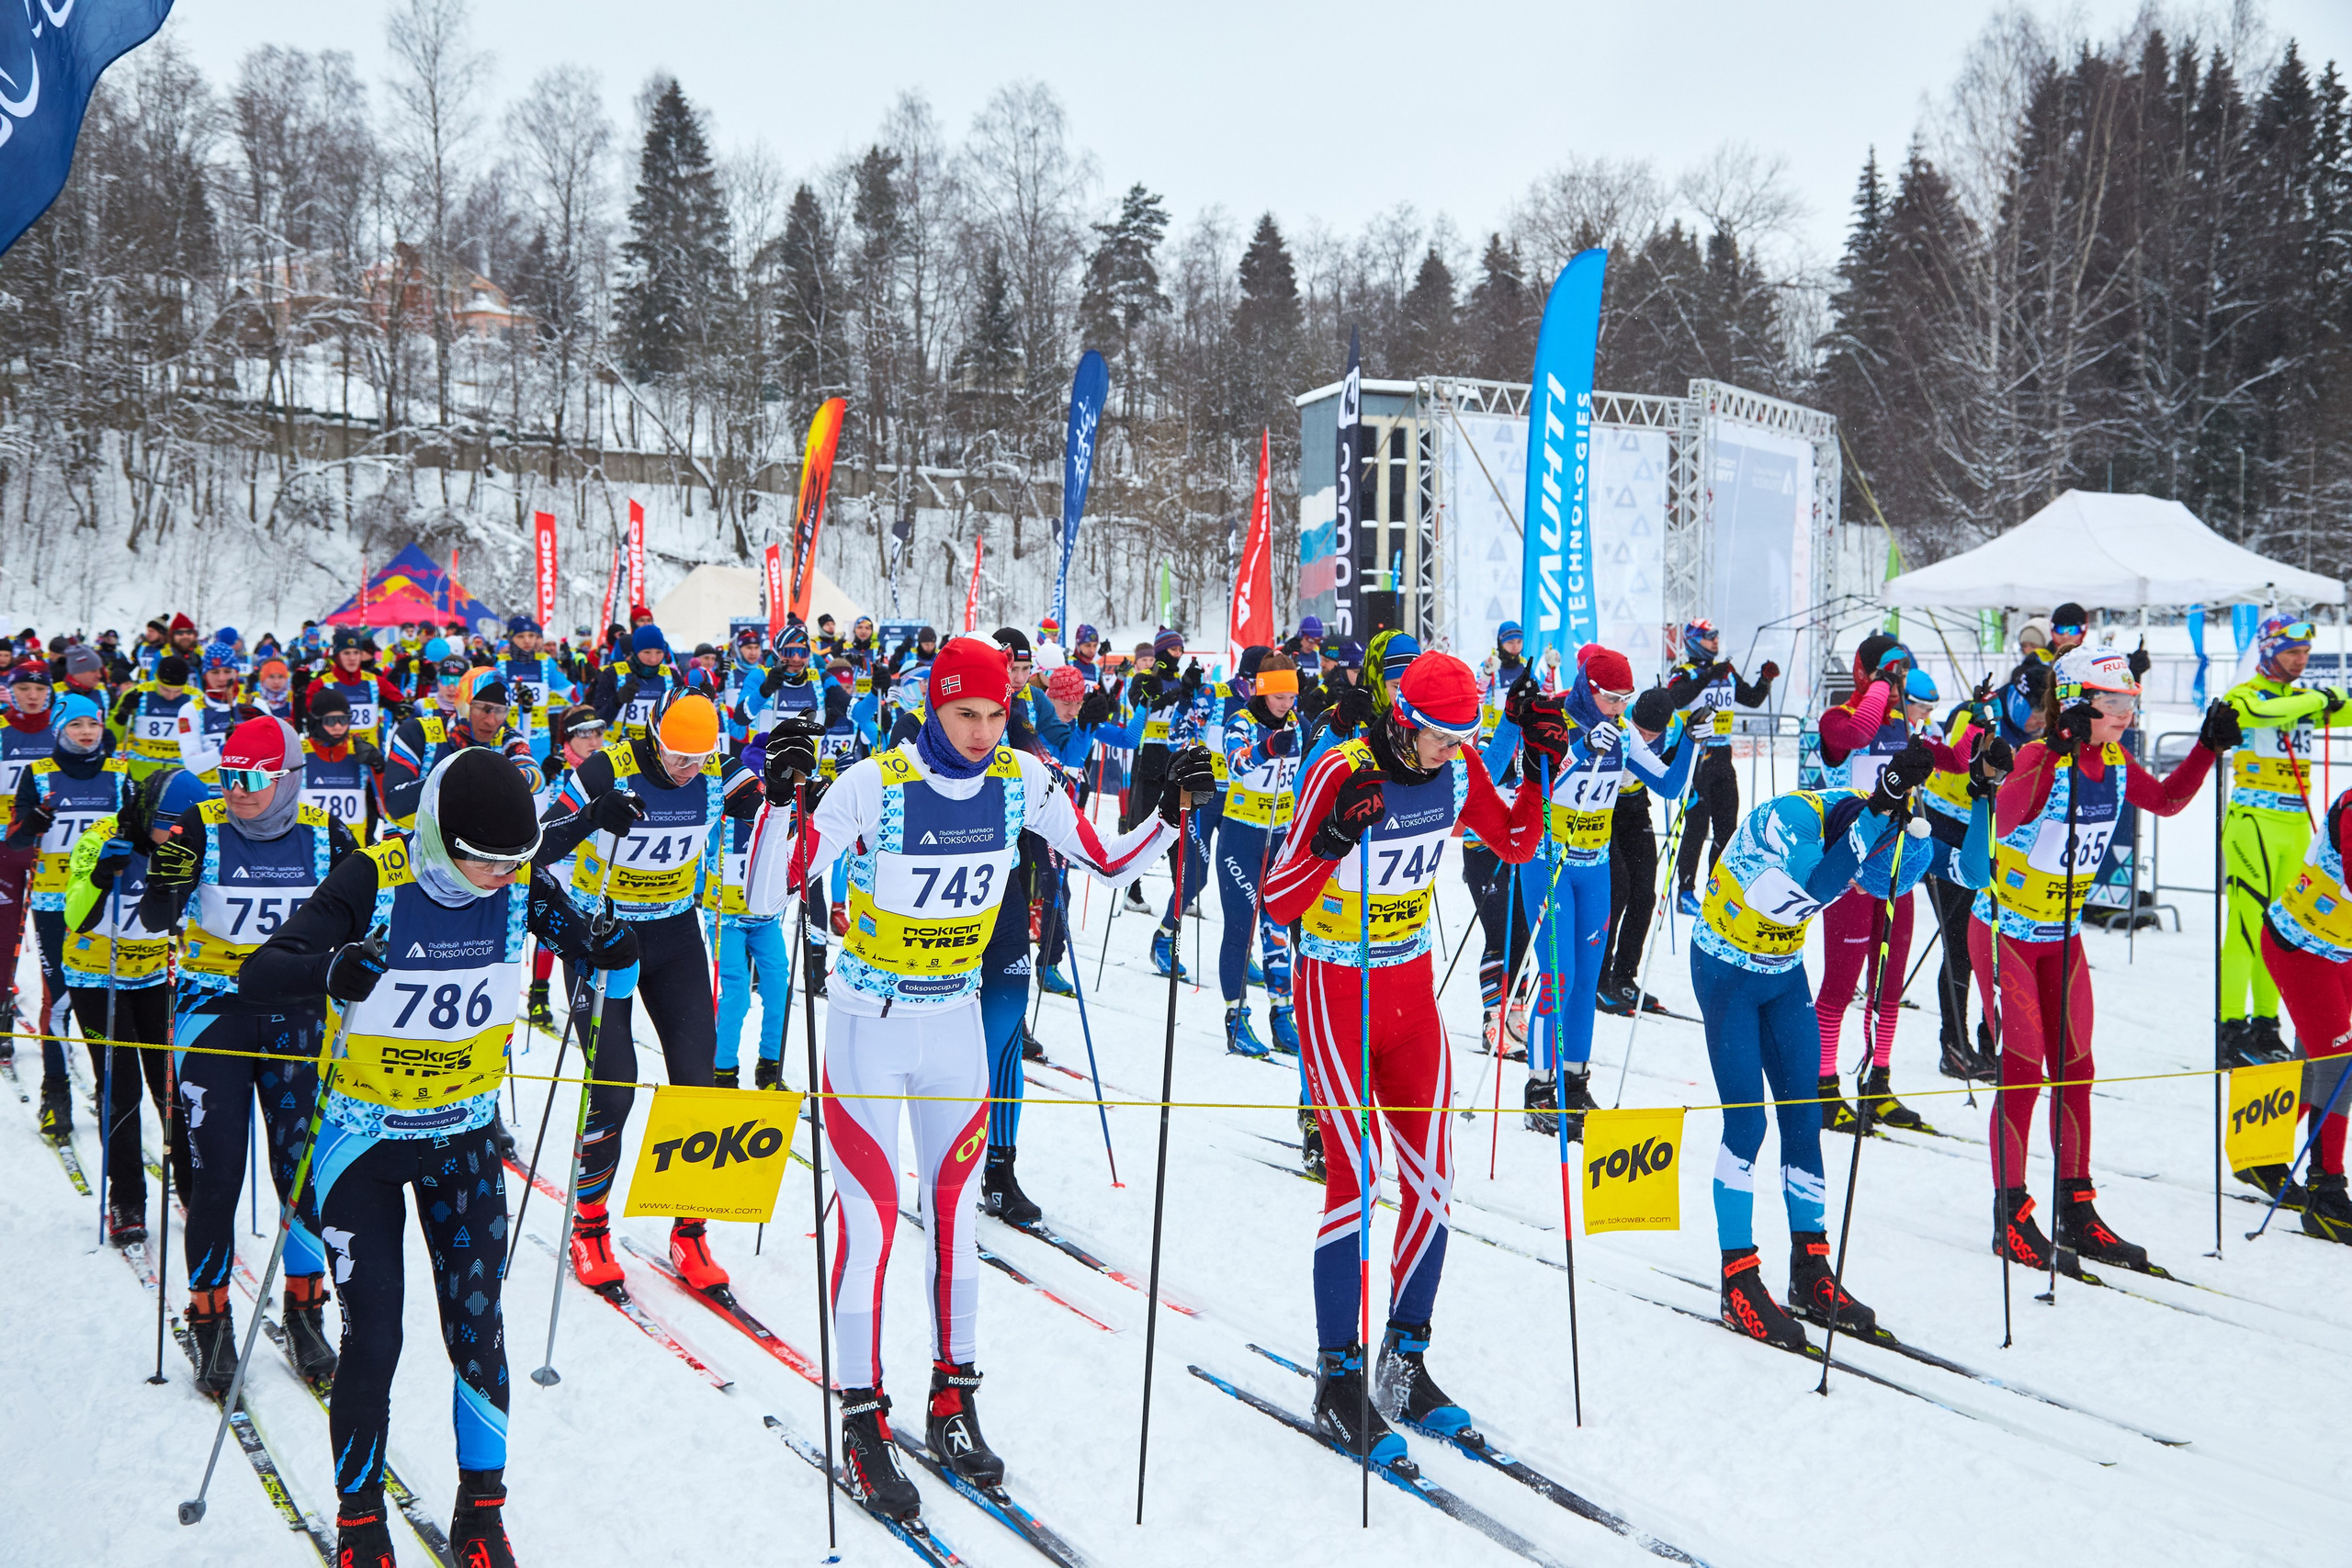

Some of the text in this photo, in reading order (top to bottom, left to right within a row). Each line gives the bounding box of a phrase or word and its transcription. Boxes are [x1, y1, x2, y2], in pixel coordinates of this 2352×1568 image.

[1539, 372, 1566, 632] VAUHTI
[1568, 392, 1591, 630] TECHNOLOGIES
[511, 688, 540, 702] 83
[1705, 693, 1732, 706] 806
[149, 722, 175, 737] 87
[2277, 729, 2312, 752] 843
[615, 751, 632, 768] 10
[1351, 750, 1372, 761] 10
[883, 759, 909, 773] 10
[997, 766, 1009, 774] KM
[204, 802, 226, 815] 10
[303, 806, 324, 817] 10
[312, 795, 356, 818] 780
[1424, 807, 1444, 816] МАРАФОН
[1400, 813, 1444, 828] TOKSOVOCUP
[939, 834, 994, 845] TOKSOVOCUP
[627, 834, 693, 863] 741
[378, 850, 405, 871] 10
[1378, 840, 1445, 886] 744
[388, 872, 402, 882] KM
[617, 871, 682, 881] nokian
[1224, 856, 1258, 910] KOLPIN
[912, 863, 995, 909] 743
[1771, 890, 1823, 922] 74
[903, 922, 980, 935] nokian
[428, 939, 493, 949] ЛЫЖНЫЙ МАРАФОН
[902, 933, 979, 949] TYRES
[428, 946, 493, 958] TOKSOVOCUP
[905, 982, 960, 992] toksovocup.ru
[392, 977, 492, 1030] 786
[382, 1043, 474, 1063] nokian
[2233, 1087, 2295, 1134] TOKO
[392, 1113, 461, 1127] toksovocup.ru
[652, 1119, 784, 1173] TOKO
[1589, 1135, 1674, 1190] TOKO
[639, 1201, 763, 1215] www.tokowax.com
[1589, 1215, 1671, 1226] www.tokowax.com
[1730, 1288, 1768, 1339] ROSSI
[1328, 1408, 1351, 1443] salomon
[260, 1473, 299, 1523] FISCHER
[956, 1481, 988, 1508] salomon
[342, 1515, 378, 1527] ROSSIGNOL
